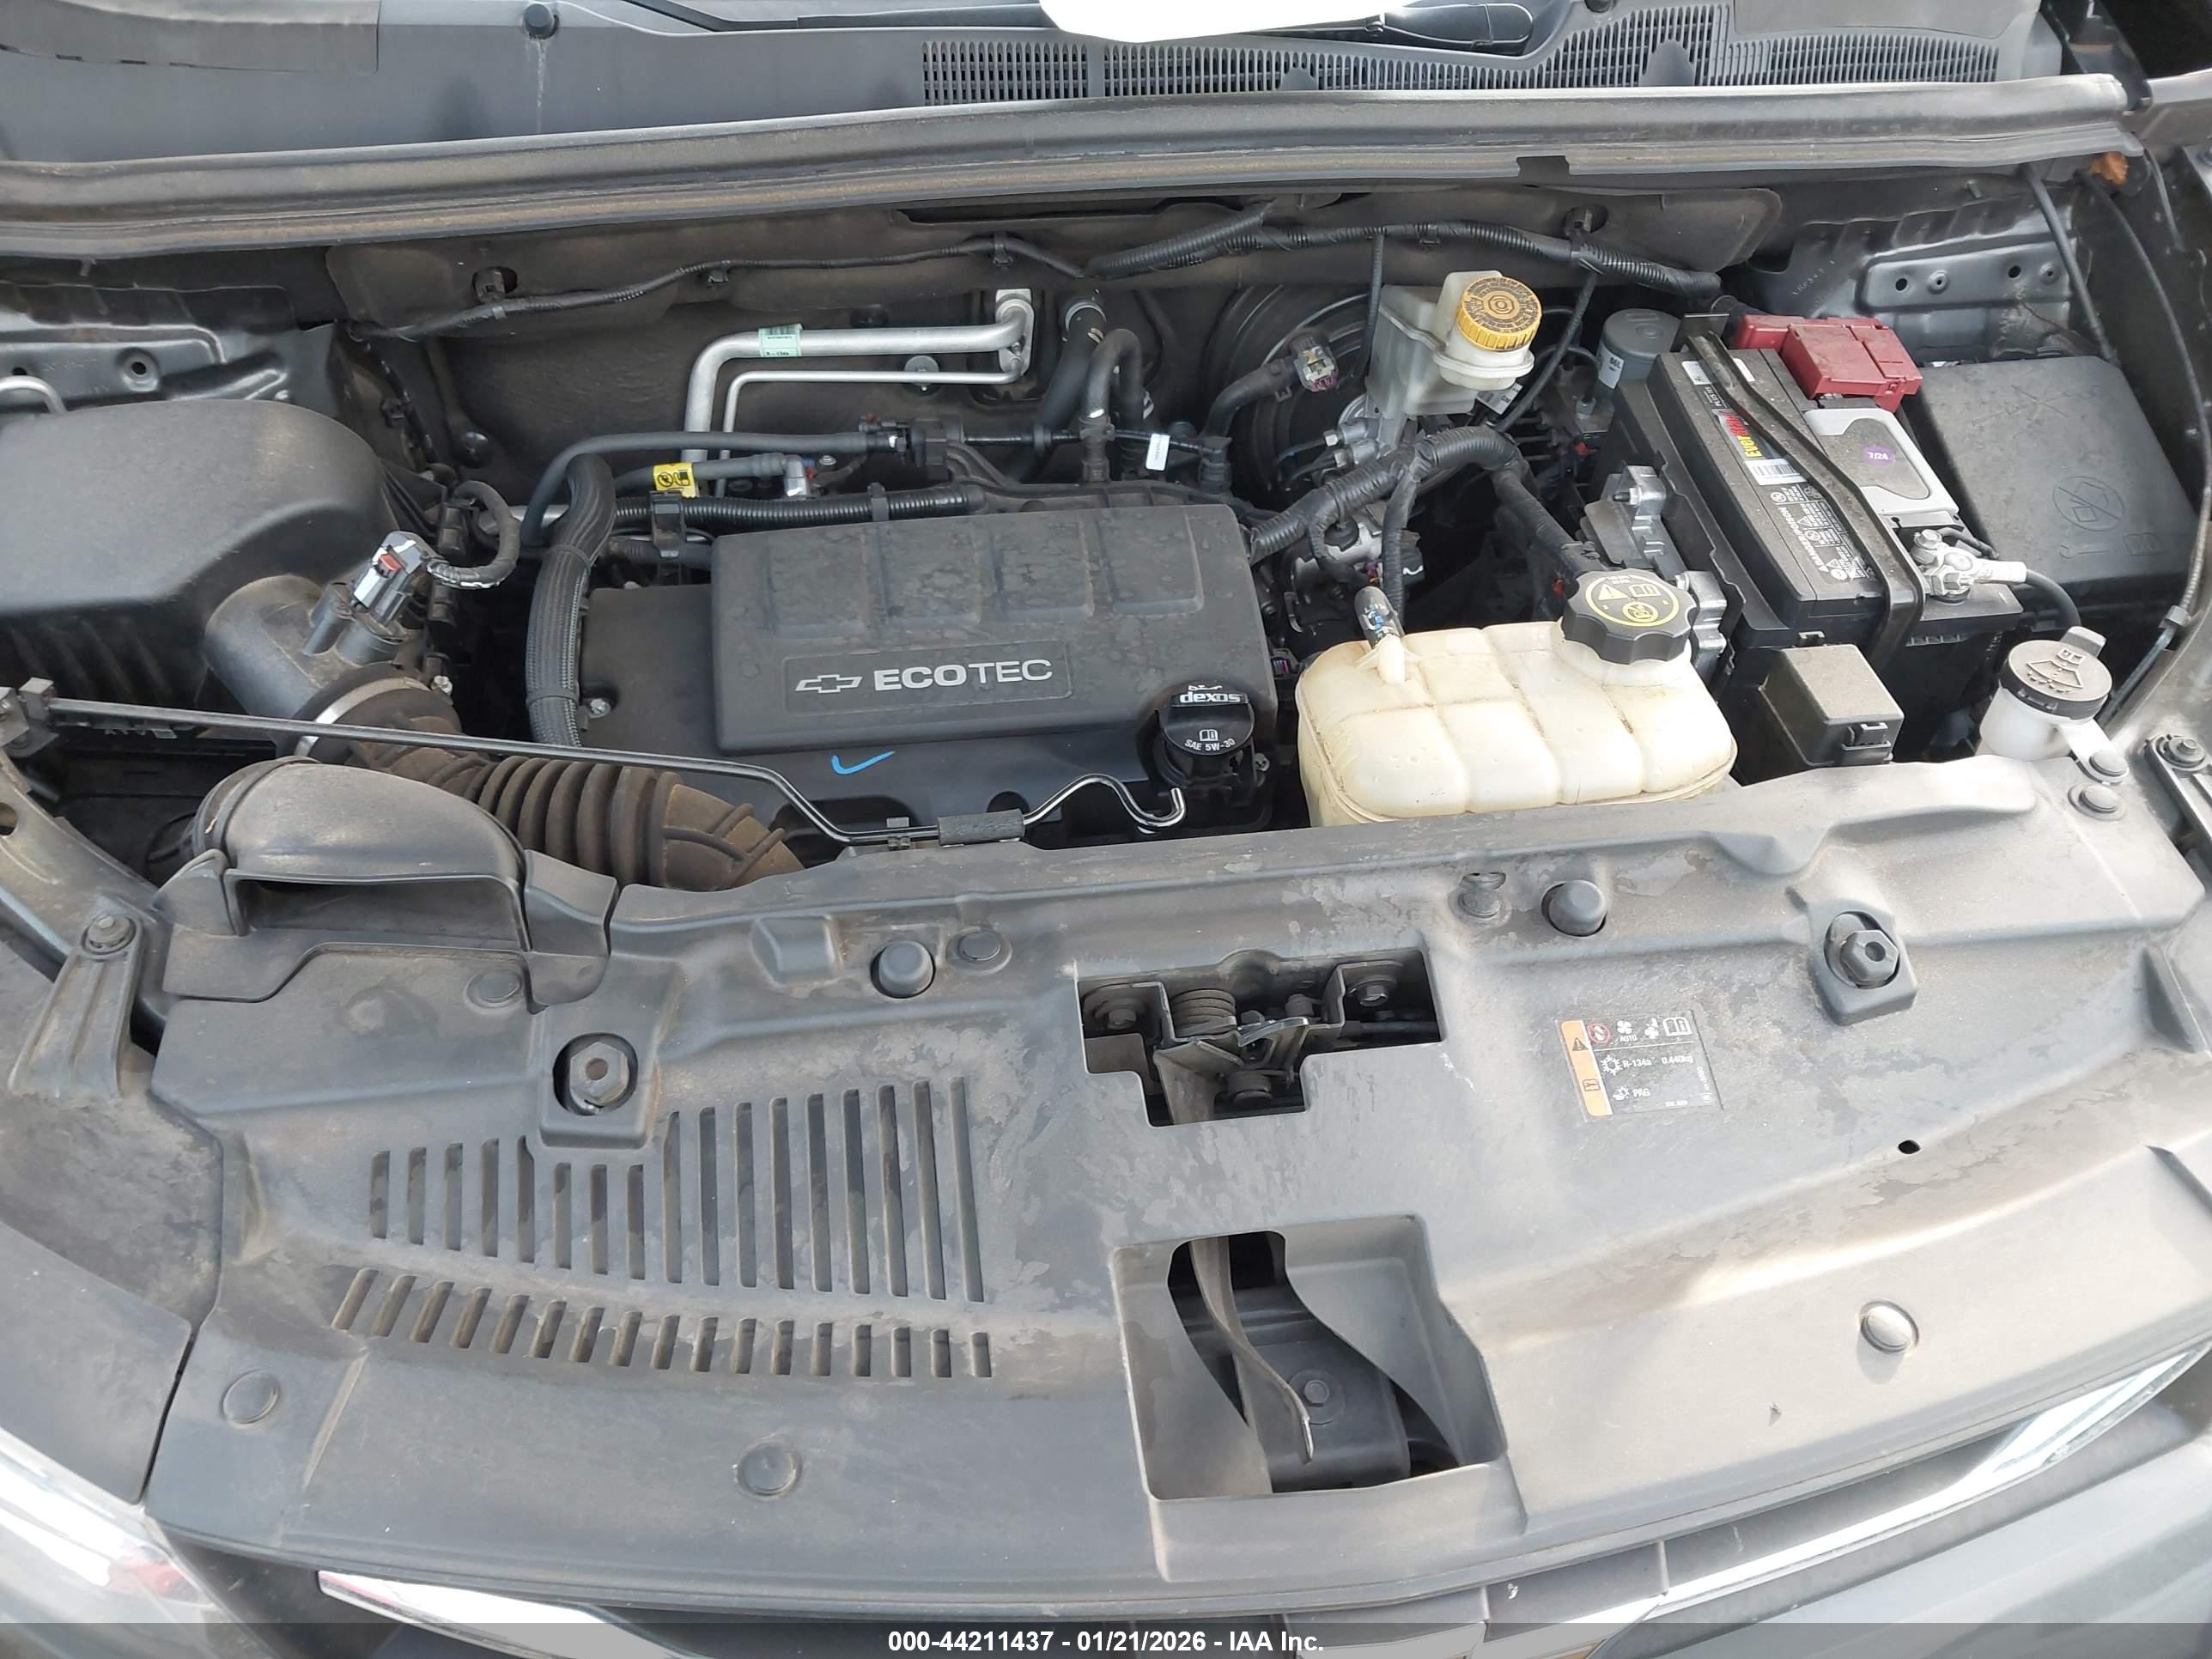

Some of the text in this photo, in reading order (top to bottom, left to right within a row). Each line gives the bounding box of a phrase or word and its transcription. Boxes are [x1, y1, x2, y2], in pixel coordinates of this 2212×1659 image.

[1778, 507, 1826, 568] DANGER/POISON
[873, 659, 1053, 691] ECOTEC
[1180, 690, 1243, 703] dexos
[1184, 738, 1236, 751] SAE 5W-30
[1622, 1058, 1652, 1068] R-134a
[1632, 1088, 1650, 1097] PAG
